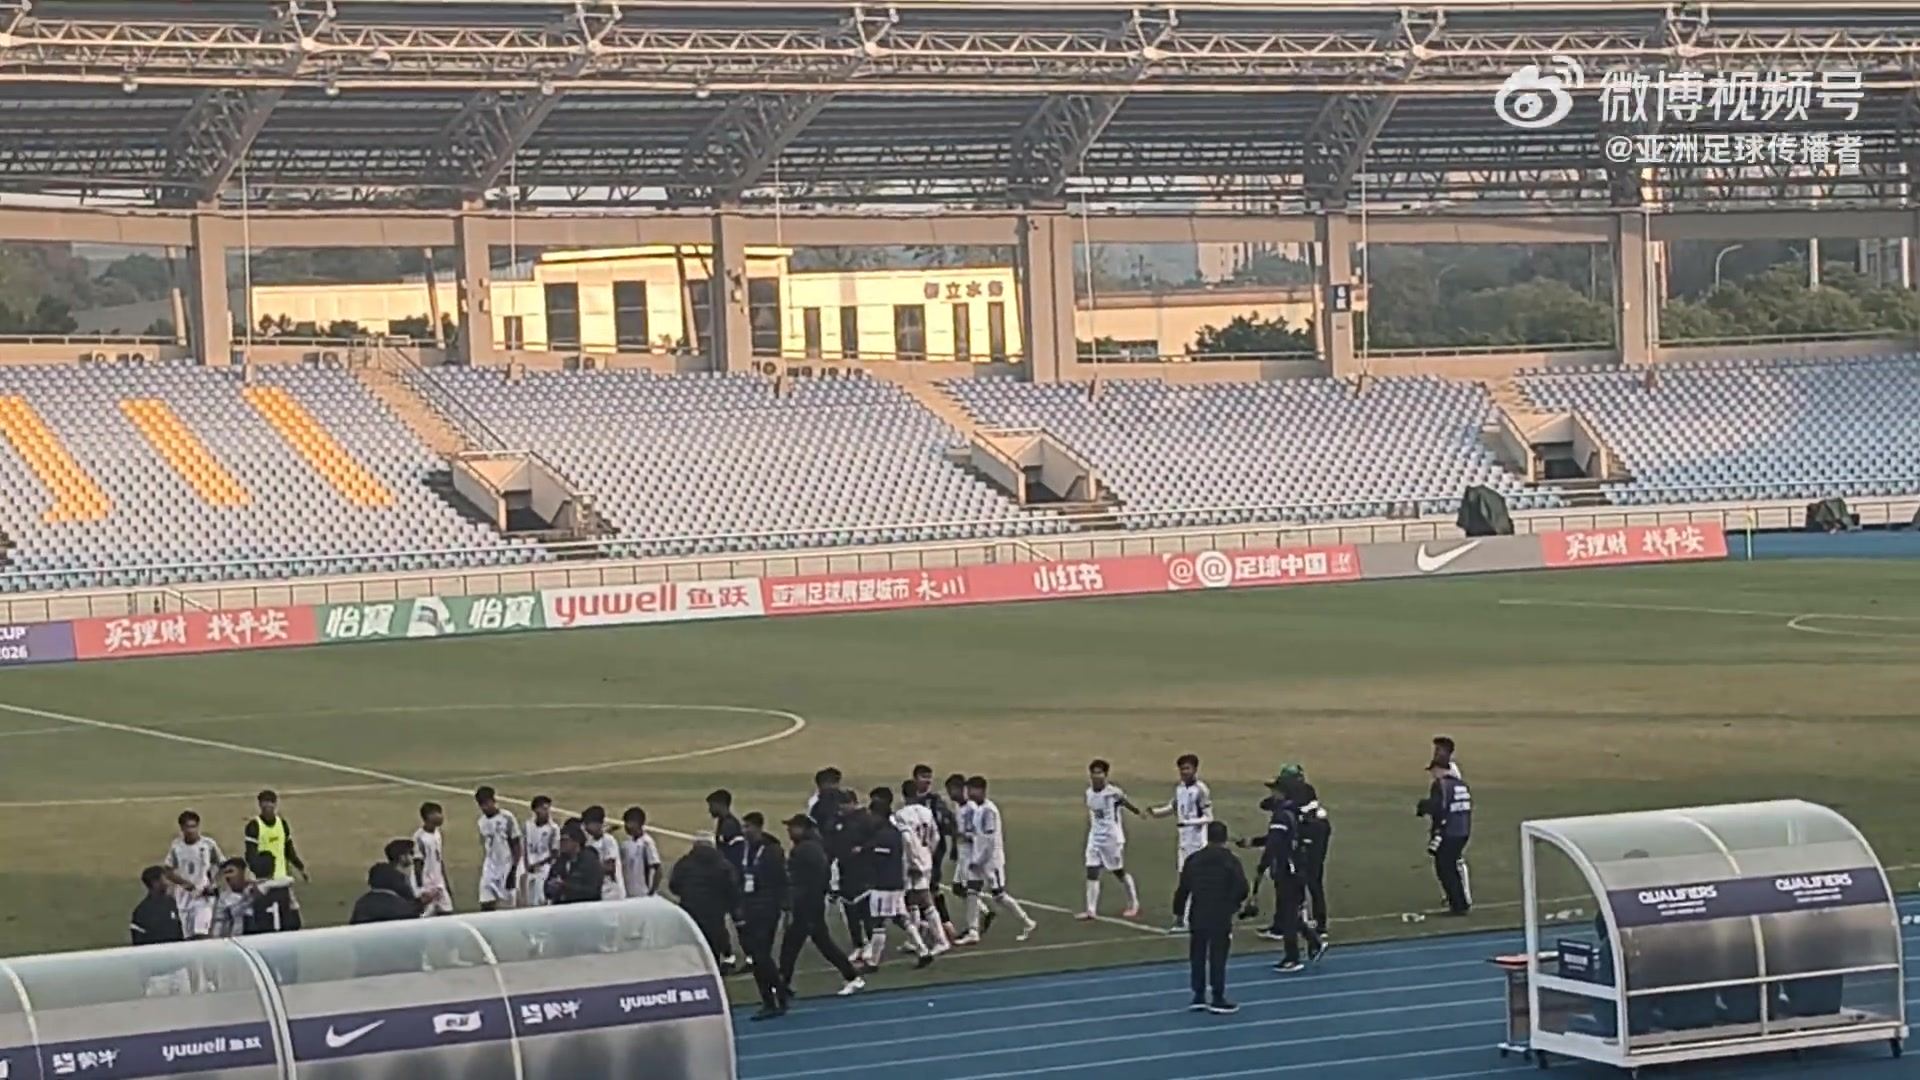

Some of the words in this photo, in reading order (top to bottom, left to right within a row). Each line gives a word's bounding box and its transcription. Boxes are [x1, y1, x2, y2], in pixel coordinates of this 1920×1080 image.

[1565, 530, 1627, 558] 买理财
[1642, 526, 1705, 557] 找平安
[1033, 562, 1104, 593] 小红书
[1234, 552, 1328, 581] 足球中国
[554, 583, 677, 625] yuwell
[686, 585, 750, 610] 鱼跃
[770, 578, 909, 608] 亚洲足球展望城市
[914, 571, 966, 602] 永川
[104, 614, 188, 652] 买理财
[207, 612, 290, 644] 找平安
[1638, 884, 1718, 905] QUALIFIERS
[1776, 873, 1852, 892] QUALIFIERS
[619, 988, 678, 1013] yuwell
[162, 1036, 226, 1061] yuwell
